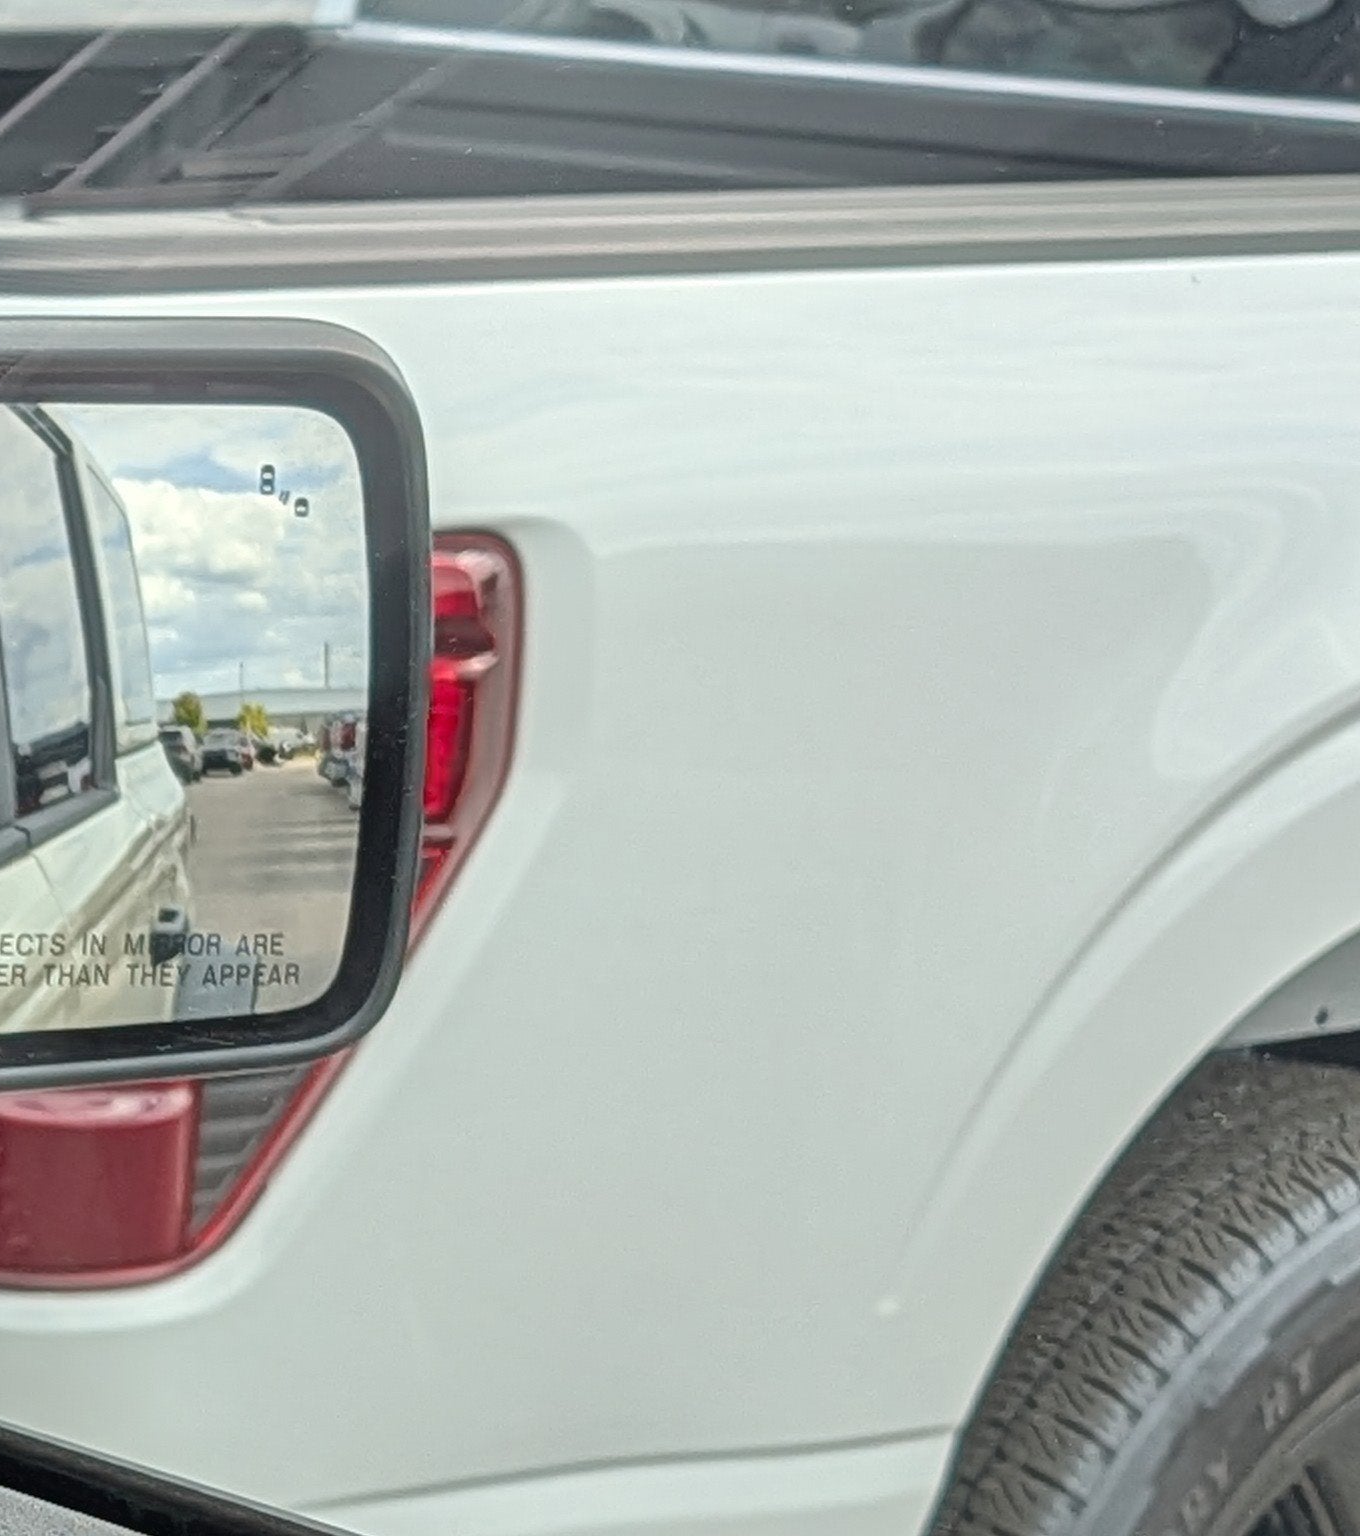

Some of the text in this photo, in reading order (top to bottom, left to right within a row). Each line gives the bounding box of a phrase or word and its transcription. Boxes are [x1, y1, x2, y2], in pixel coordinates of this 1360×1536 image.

[81, 932, 106, 957] IN
[235, 932, 285, 956] ARE
[45, 963, 111, 987] THAN
[127, 962, 190, 987] THEY
[201, 962, 300, 986] APPEAR
